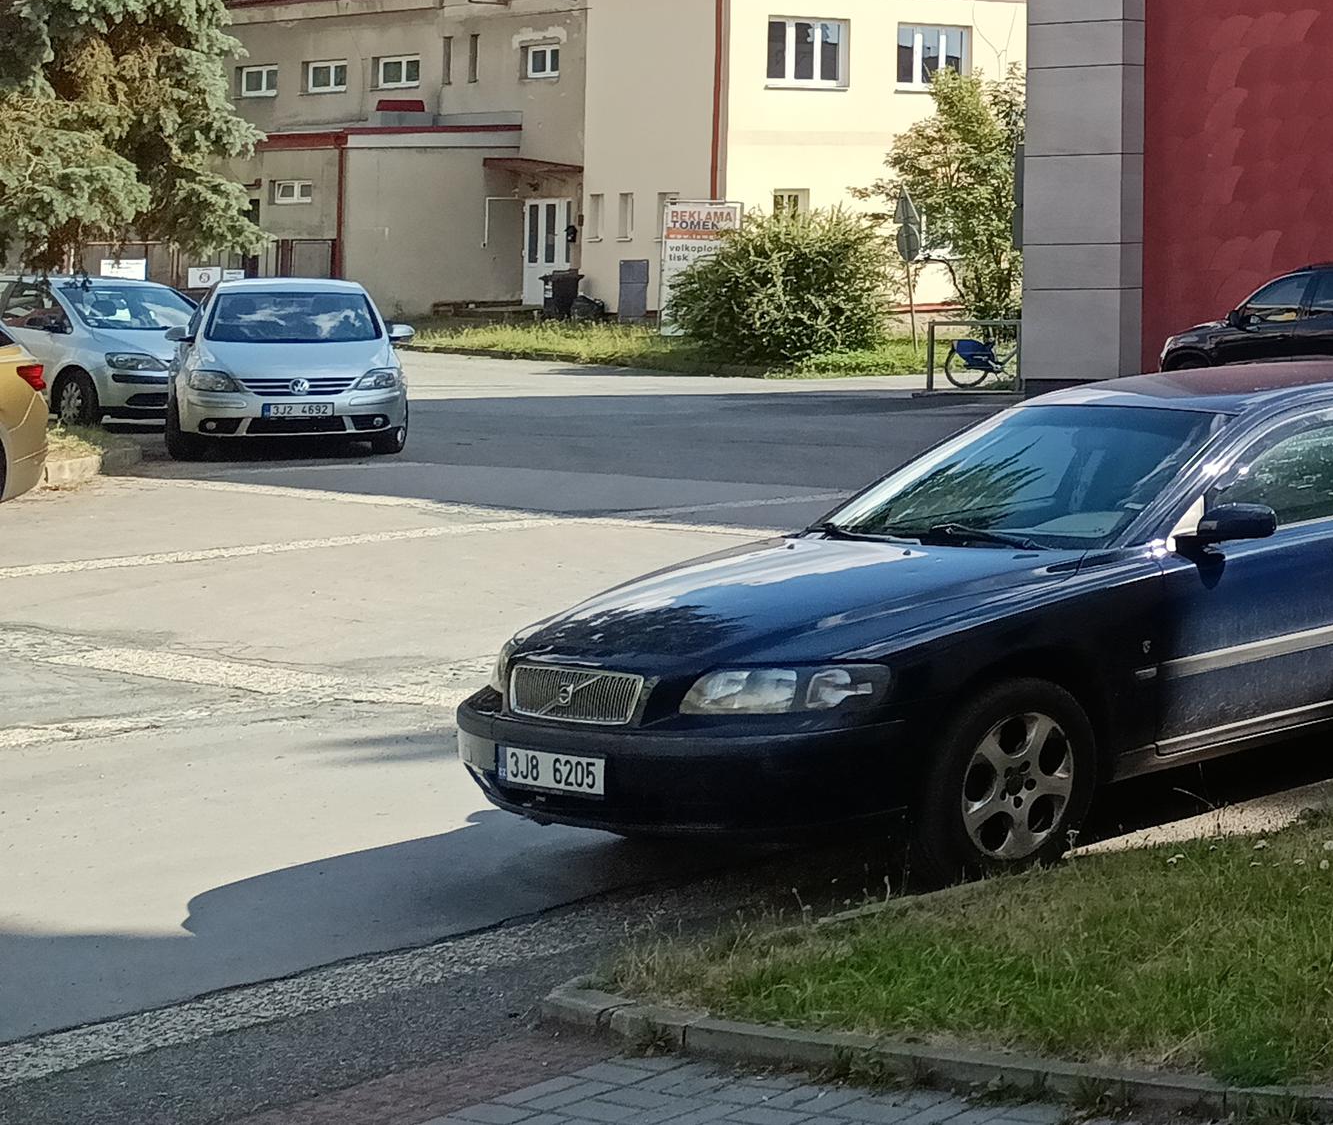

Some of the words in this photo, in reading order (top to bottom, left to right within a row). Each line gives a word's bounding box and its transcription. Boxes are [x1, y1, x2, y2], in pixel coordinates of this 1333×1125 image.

[671, 210, 733, 223] REKLAMA
[671, 220, 720, 230] TOMEK
[669, 253, 689, 262] tisk
[272, 405, 294, 416] 3J2
[301, 404, 329, 415] 4692
[510, 751, 540, 782] 3J8
[552, 757, 597, 789] 6205
